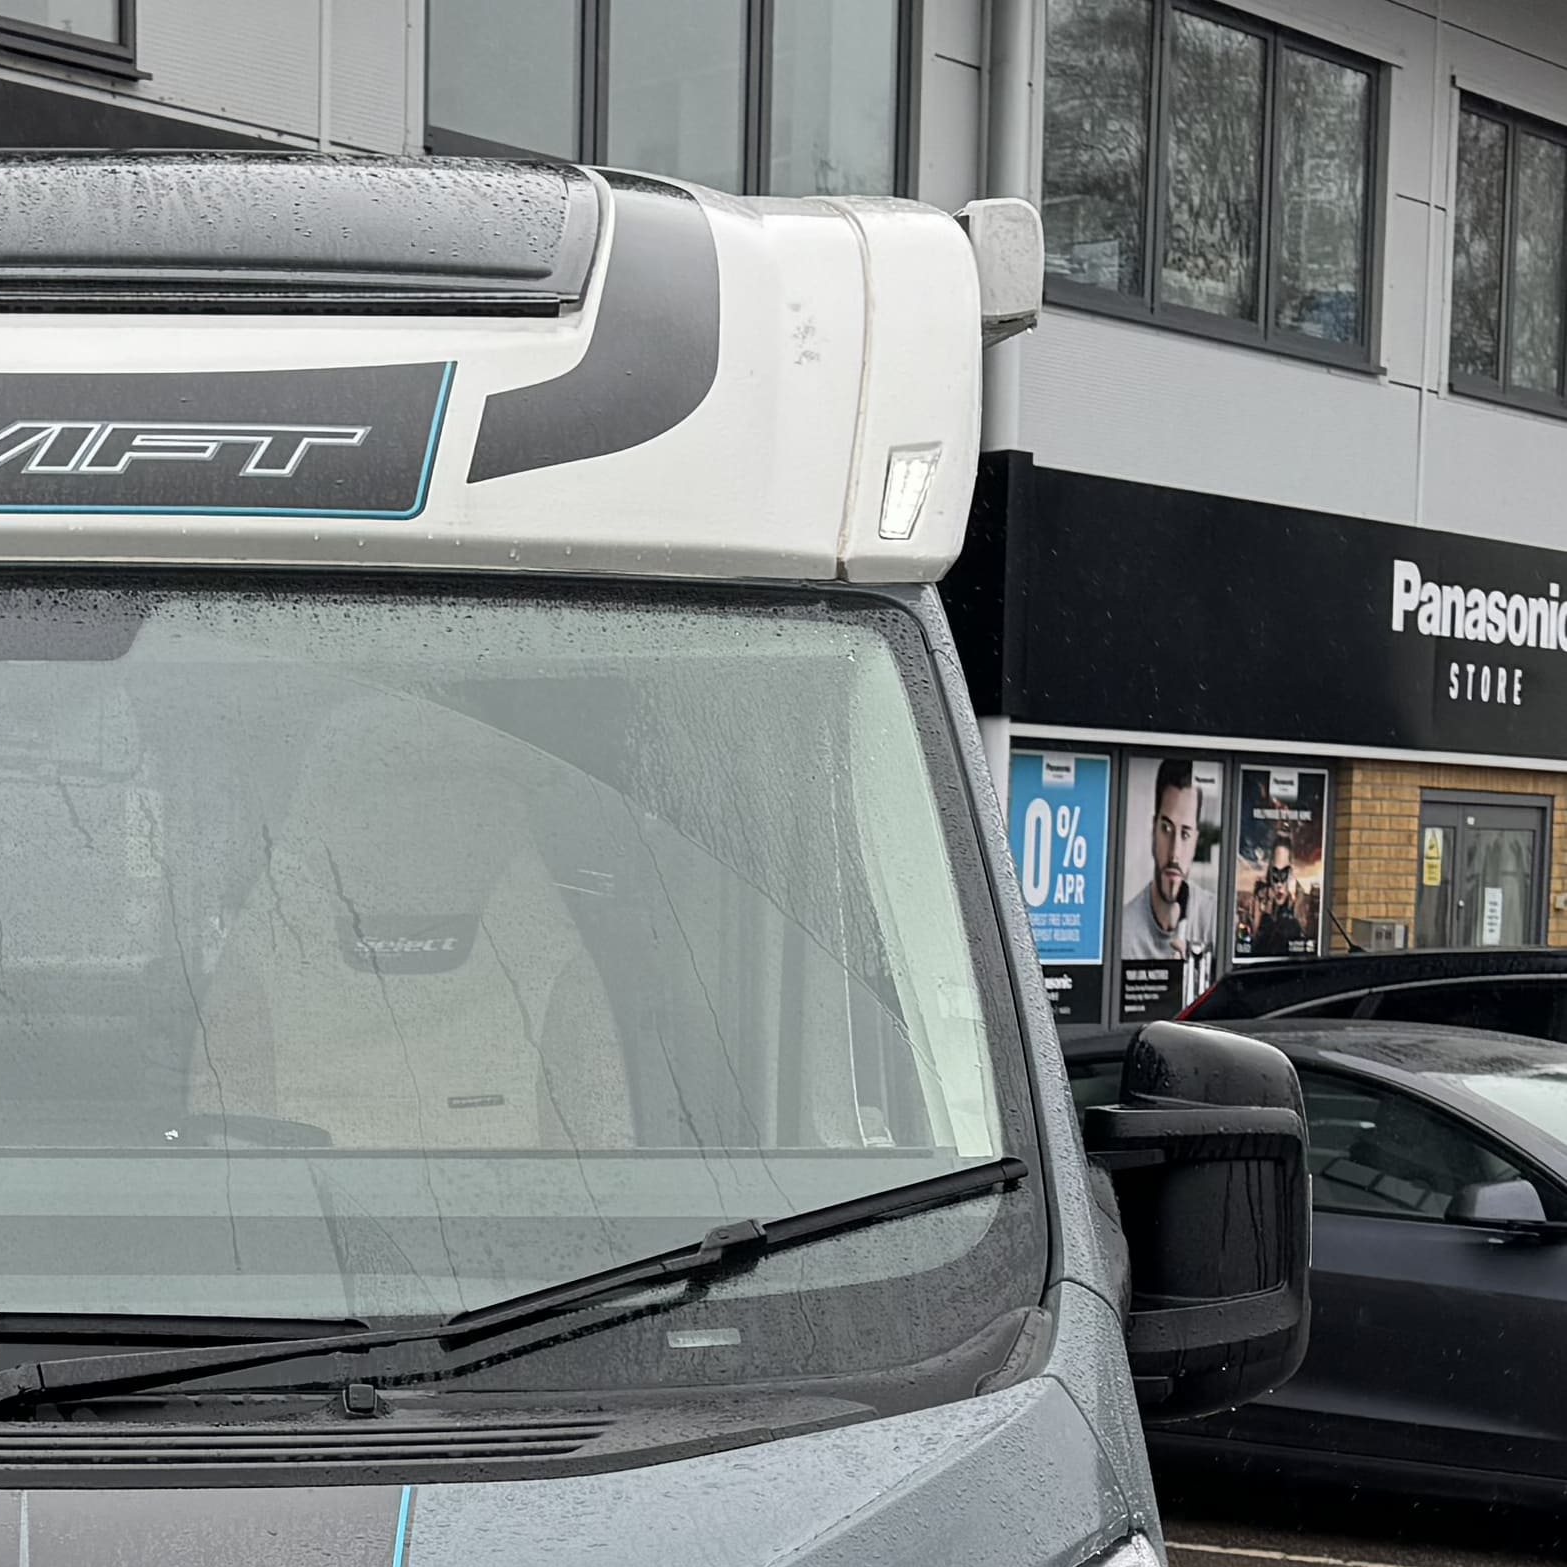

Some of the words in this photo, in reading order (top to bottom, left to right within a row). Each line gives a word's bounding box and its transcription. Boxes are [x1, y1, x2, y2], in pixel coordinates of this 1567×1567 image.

[1392, 559, 1567, 652] Panasonic
[1449, 662, 1523, 706] STORE
[1022, 797, 1088, 907] 0%
[1054, 873, 1085, 905] APR
